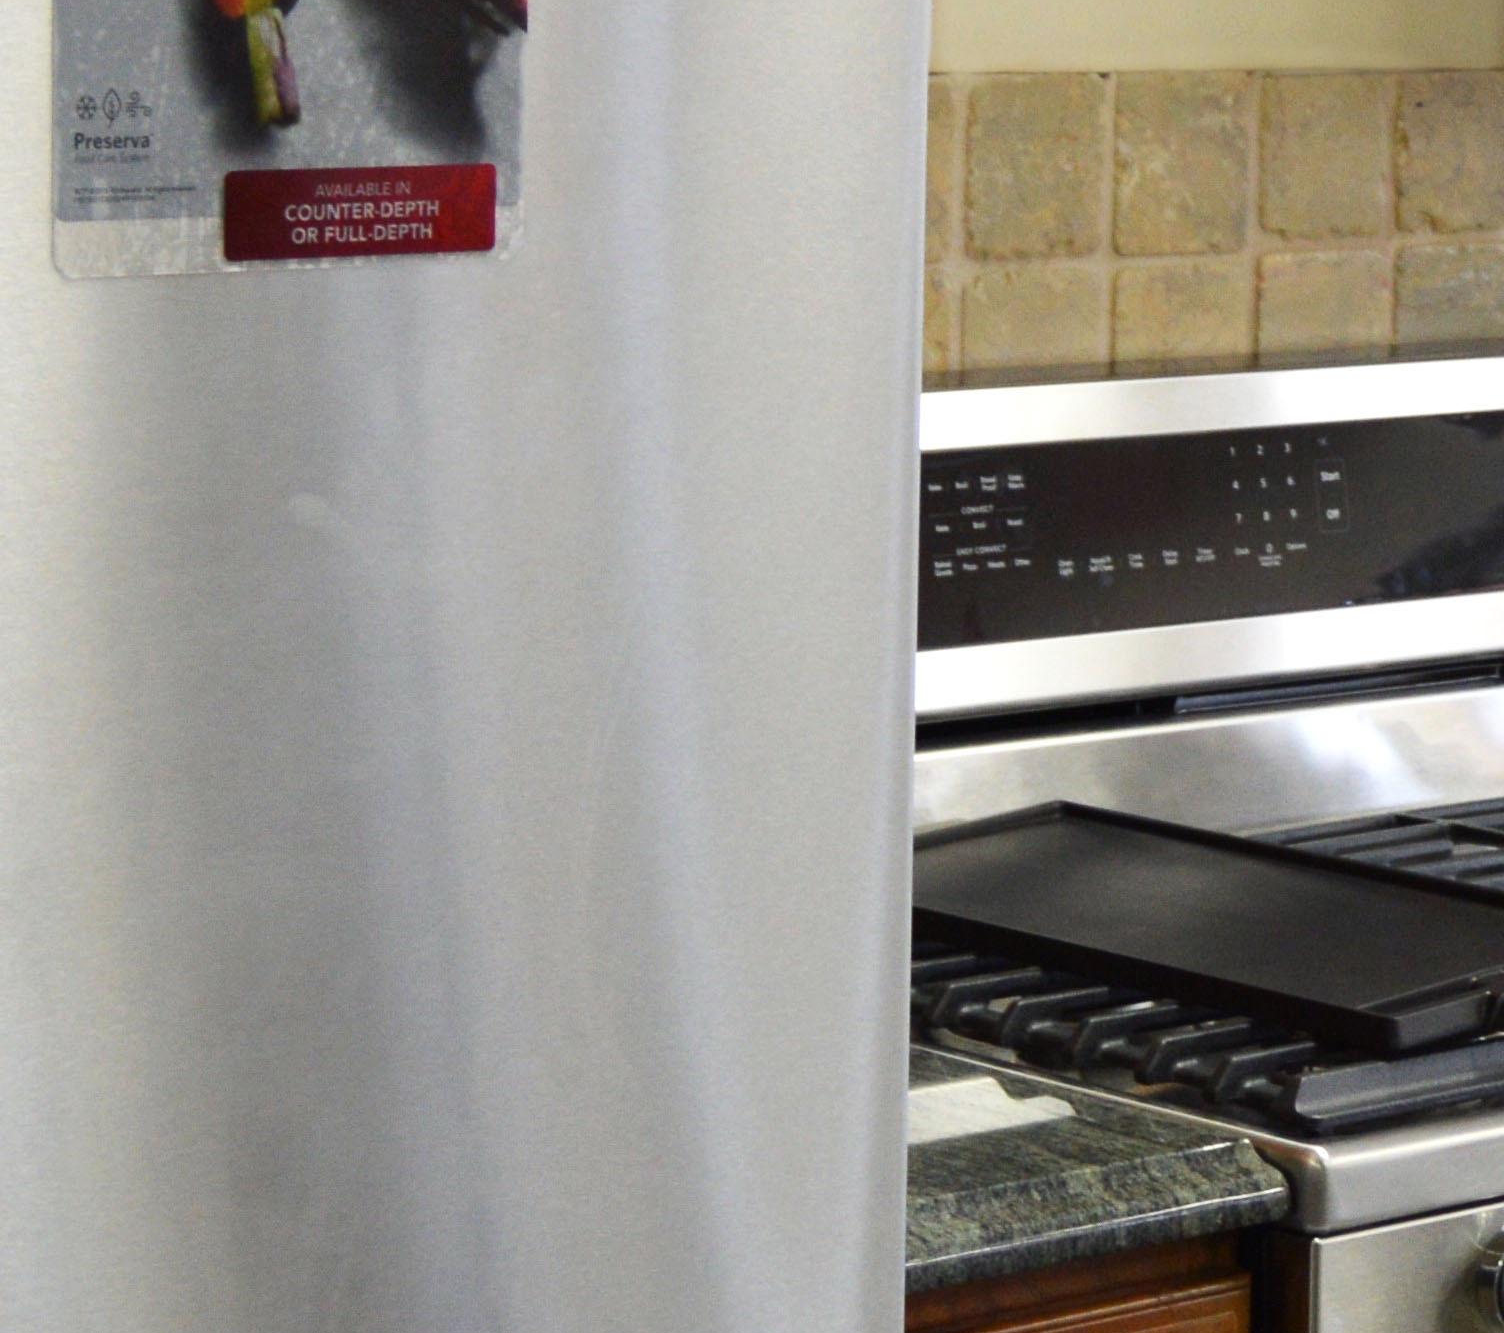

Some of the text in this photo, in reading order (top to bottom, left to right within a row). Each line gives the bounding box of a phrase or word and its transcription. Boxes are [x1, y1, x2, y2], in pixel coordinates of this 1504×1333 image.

[73, 132, 151, 150] Preserva
[314, 180, 412, 198] AVAILABLE IN
[284, 199, 441, 222] COUNTER-DEPTH
[291, 222, 433, 244] OR FULL-DEPTH
